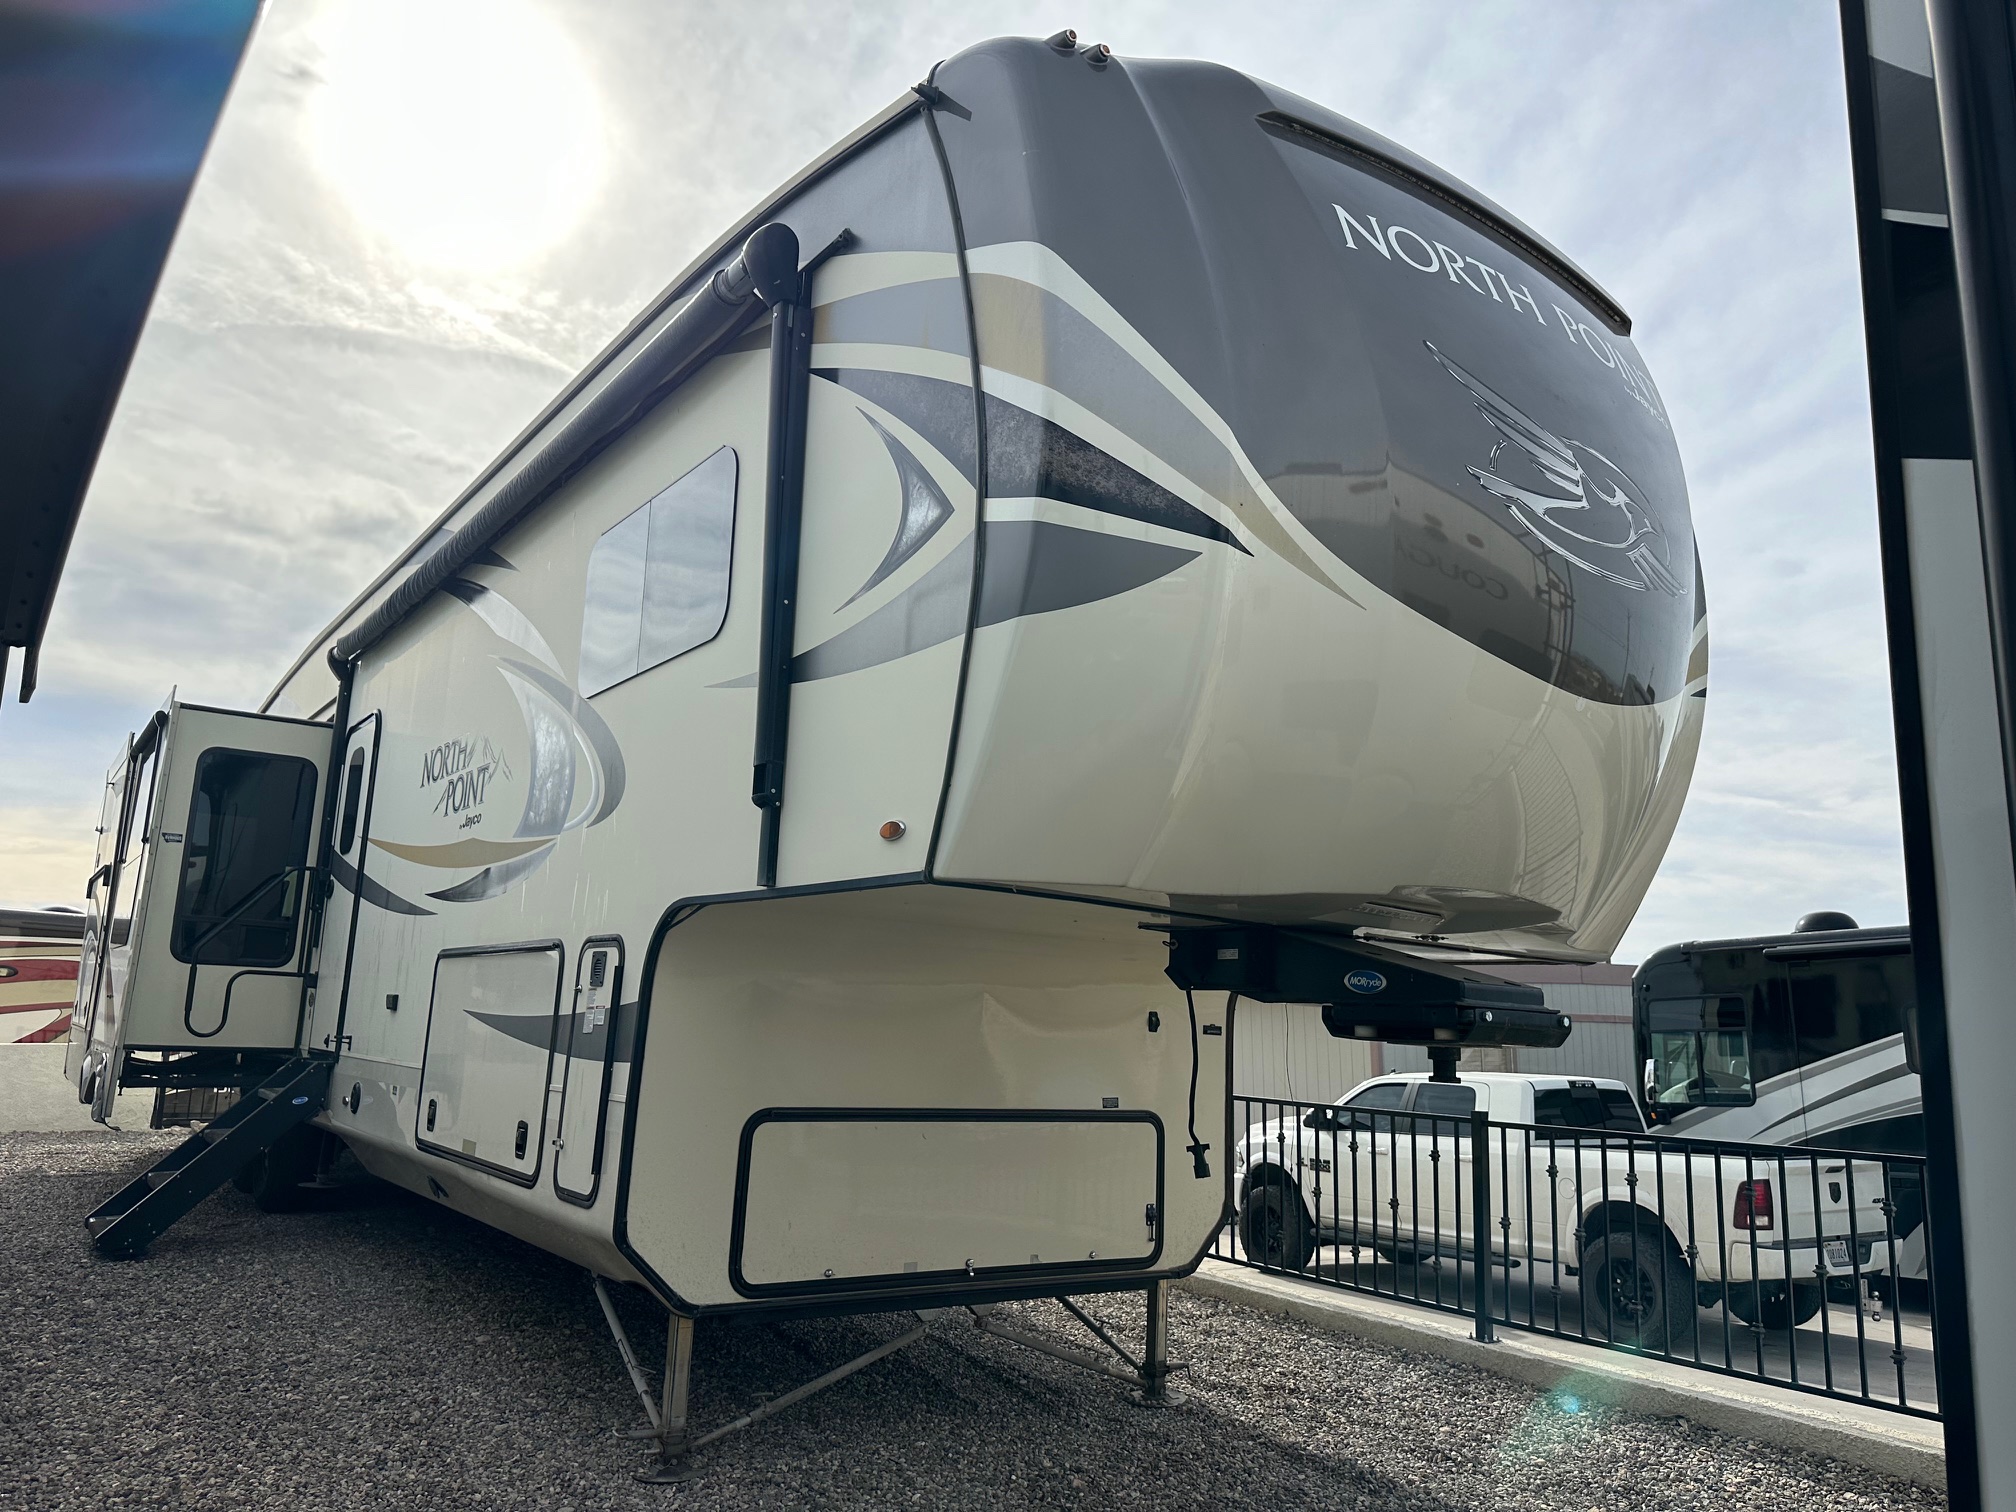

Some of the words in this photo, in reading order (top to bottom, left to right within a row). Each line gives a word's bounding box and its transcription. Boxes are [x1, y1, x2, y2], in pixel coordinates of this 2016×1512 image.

[1331, 202, 1548, 326] NORTH
[1551, 303, 1663, 415] POINT
[420, 737, 469, 789] NORTH
[434, 763, 490, 818] POINT
[463, 813, 482, 830] Jayco
[1349, 976, 1382, 988] MORryde
